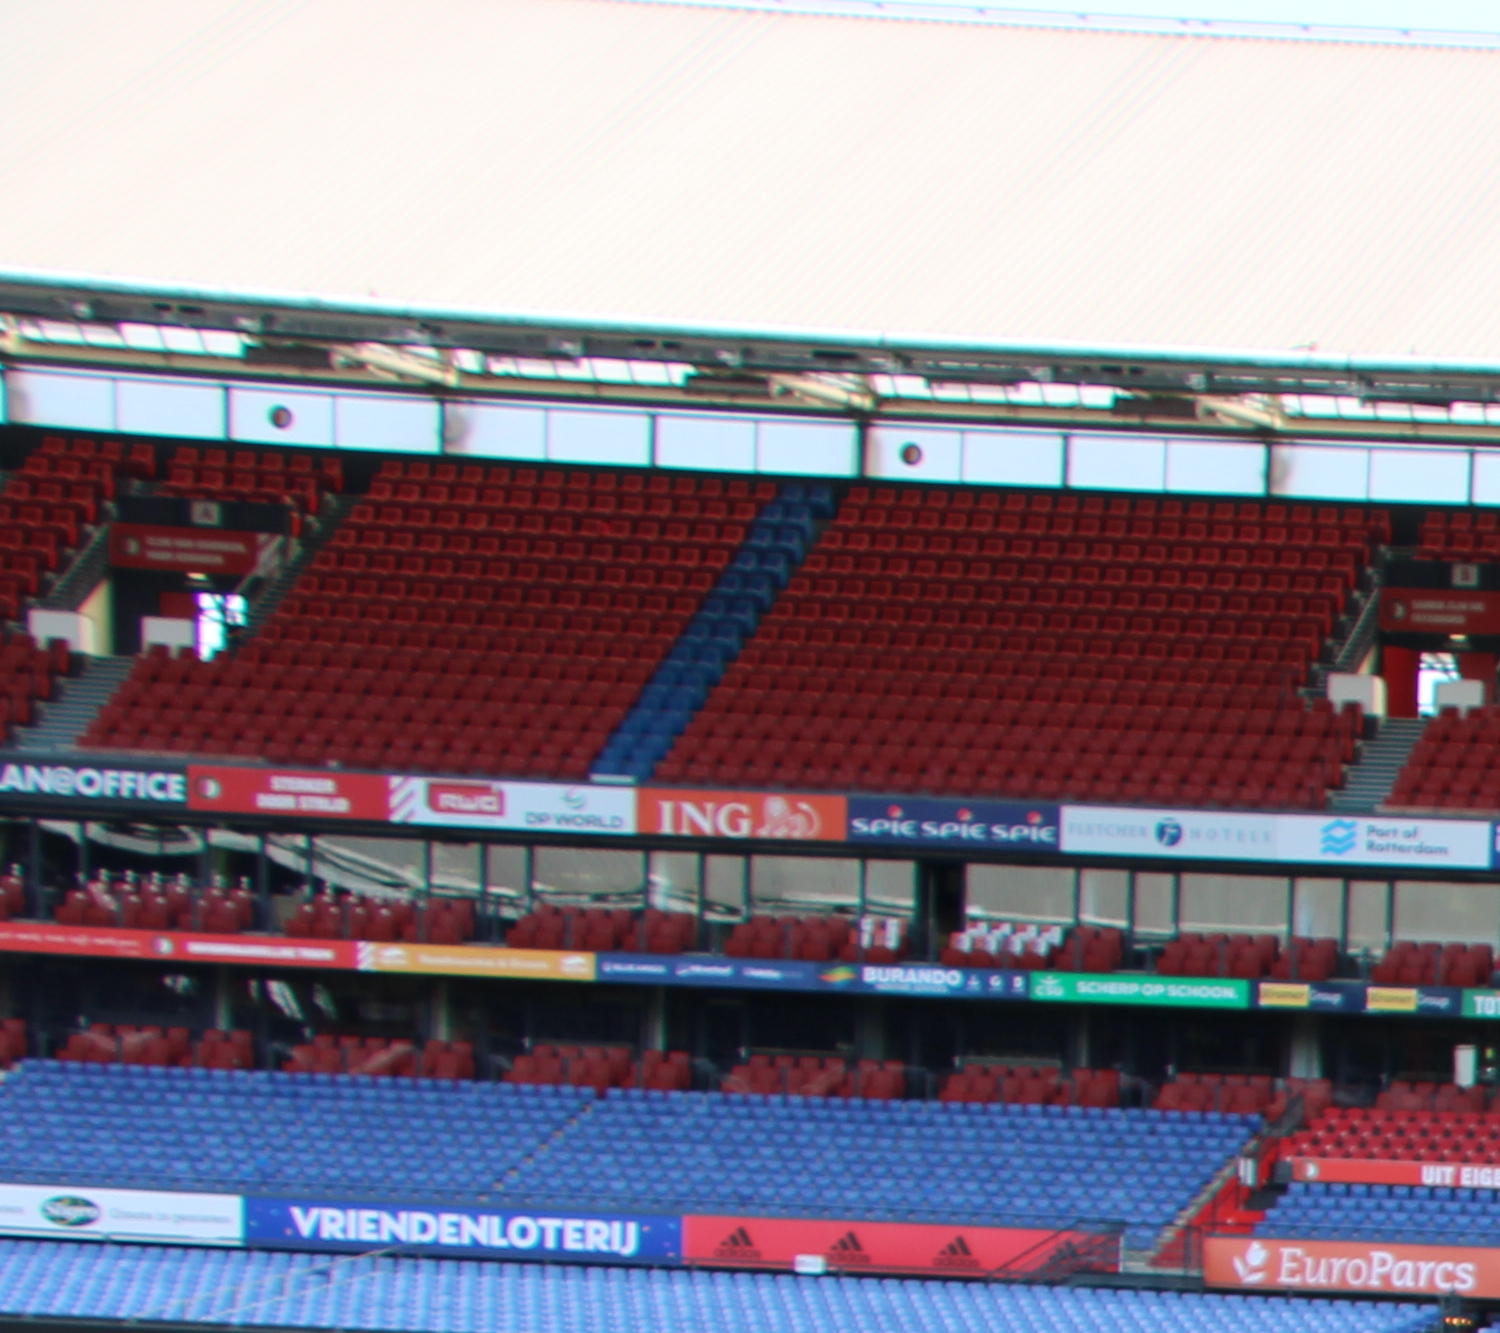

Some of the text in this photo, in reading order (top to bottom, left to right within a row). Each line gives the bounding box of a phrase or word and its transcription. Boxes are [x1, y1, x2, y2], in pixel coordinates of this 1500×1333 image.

[657, 800, 753, 839] ING
[851, 815, 1058, 844] SPIE SPIE SPIE
[1188, 827, 1272, 843] HOTELS
[1366, 825, 1419, 840] Port of
[1365, 840, 1449, 857] Rotterdam
[862, 966, 966, 988] BURANDO
[1421, 1166, 1456, 1186] UIT
[290, 1206, 641, 1257] VRIENDENLOTERIJ
[713, 1247, 762, 1260] adidas
[932, 1256, 981, 1269] adidas
[1277, 1247, 1475, 1291] EuroParcs
